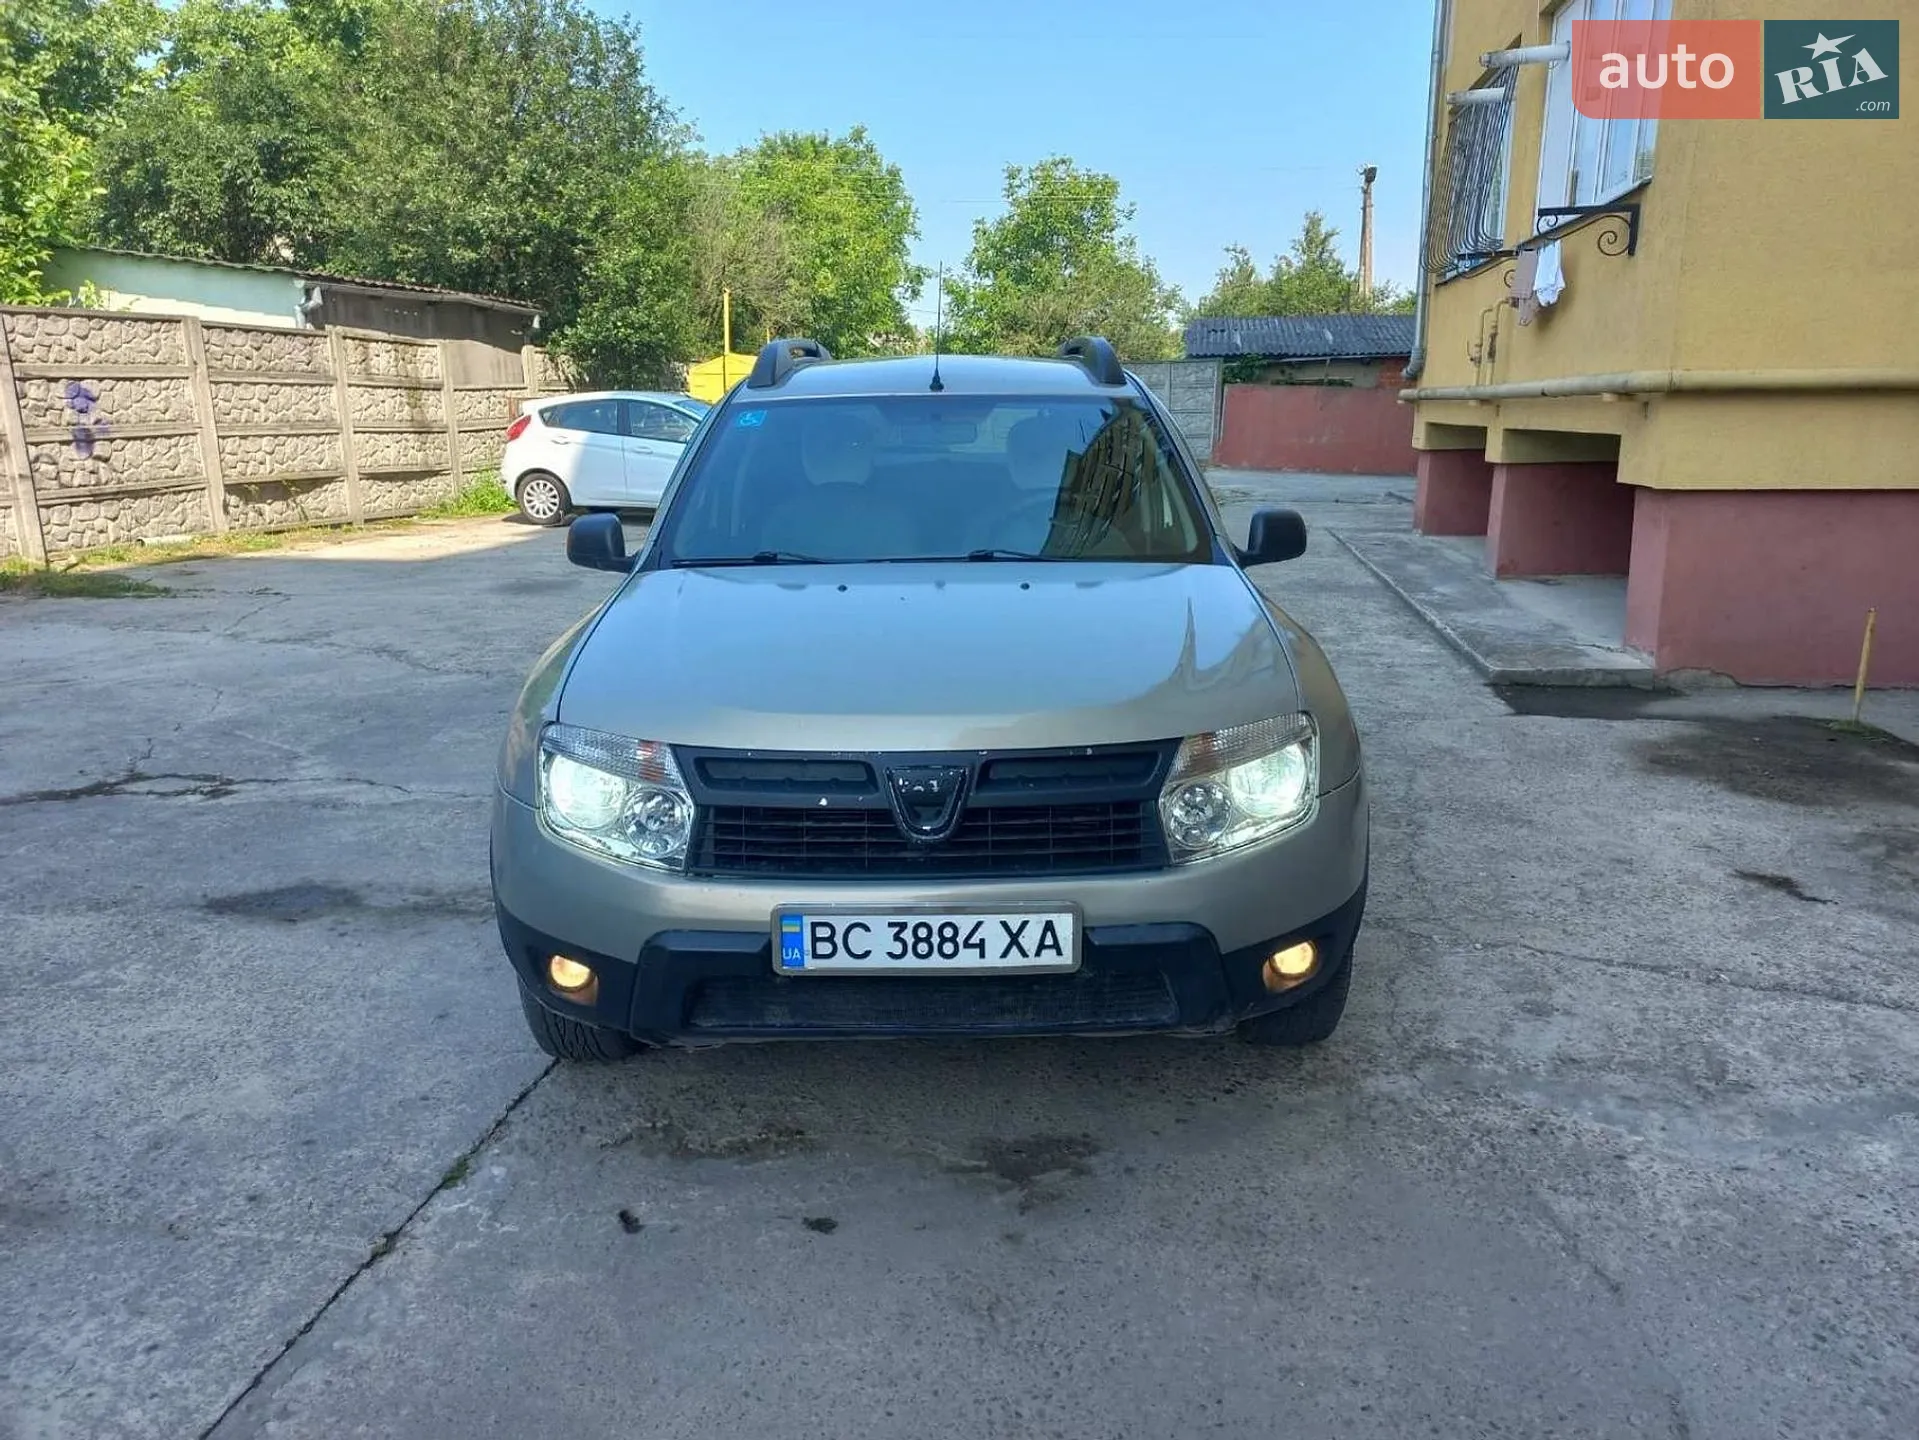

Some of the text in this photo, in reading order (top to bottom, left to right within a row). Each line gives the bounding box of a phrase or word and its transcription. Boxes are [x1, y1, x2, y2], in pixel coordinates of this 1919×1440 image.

[810, 920, 1064, 960] BC 3884 XA
[782, 947, 801, 960] UA
